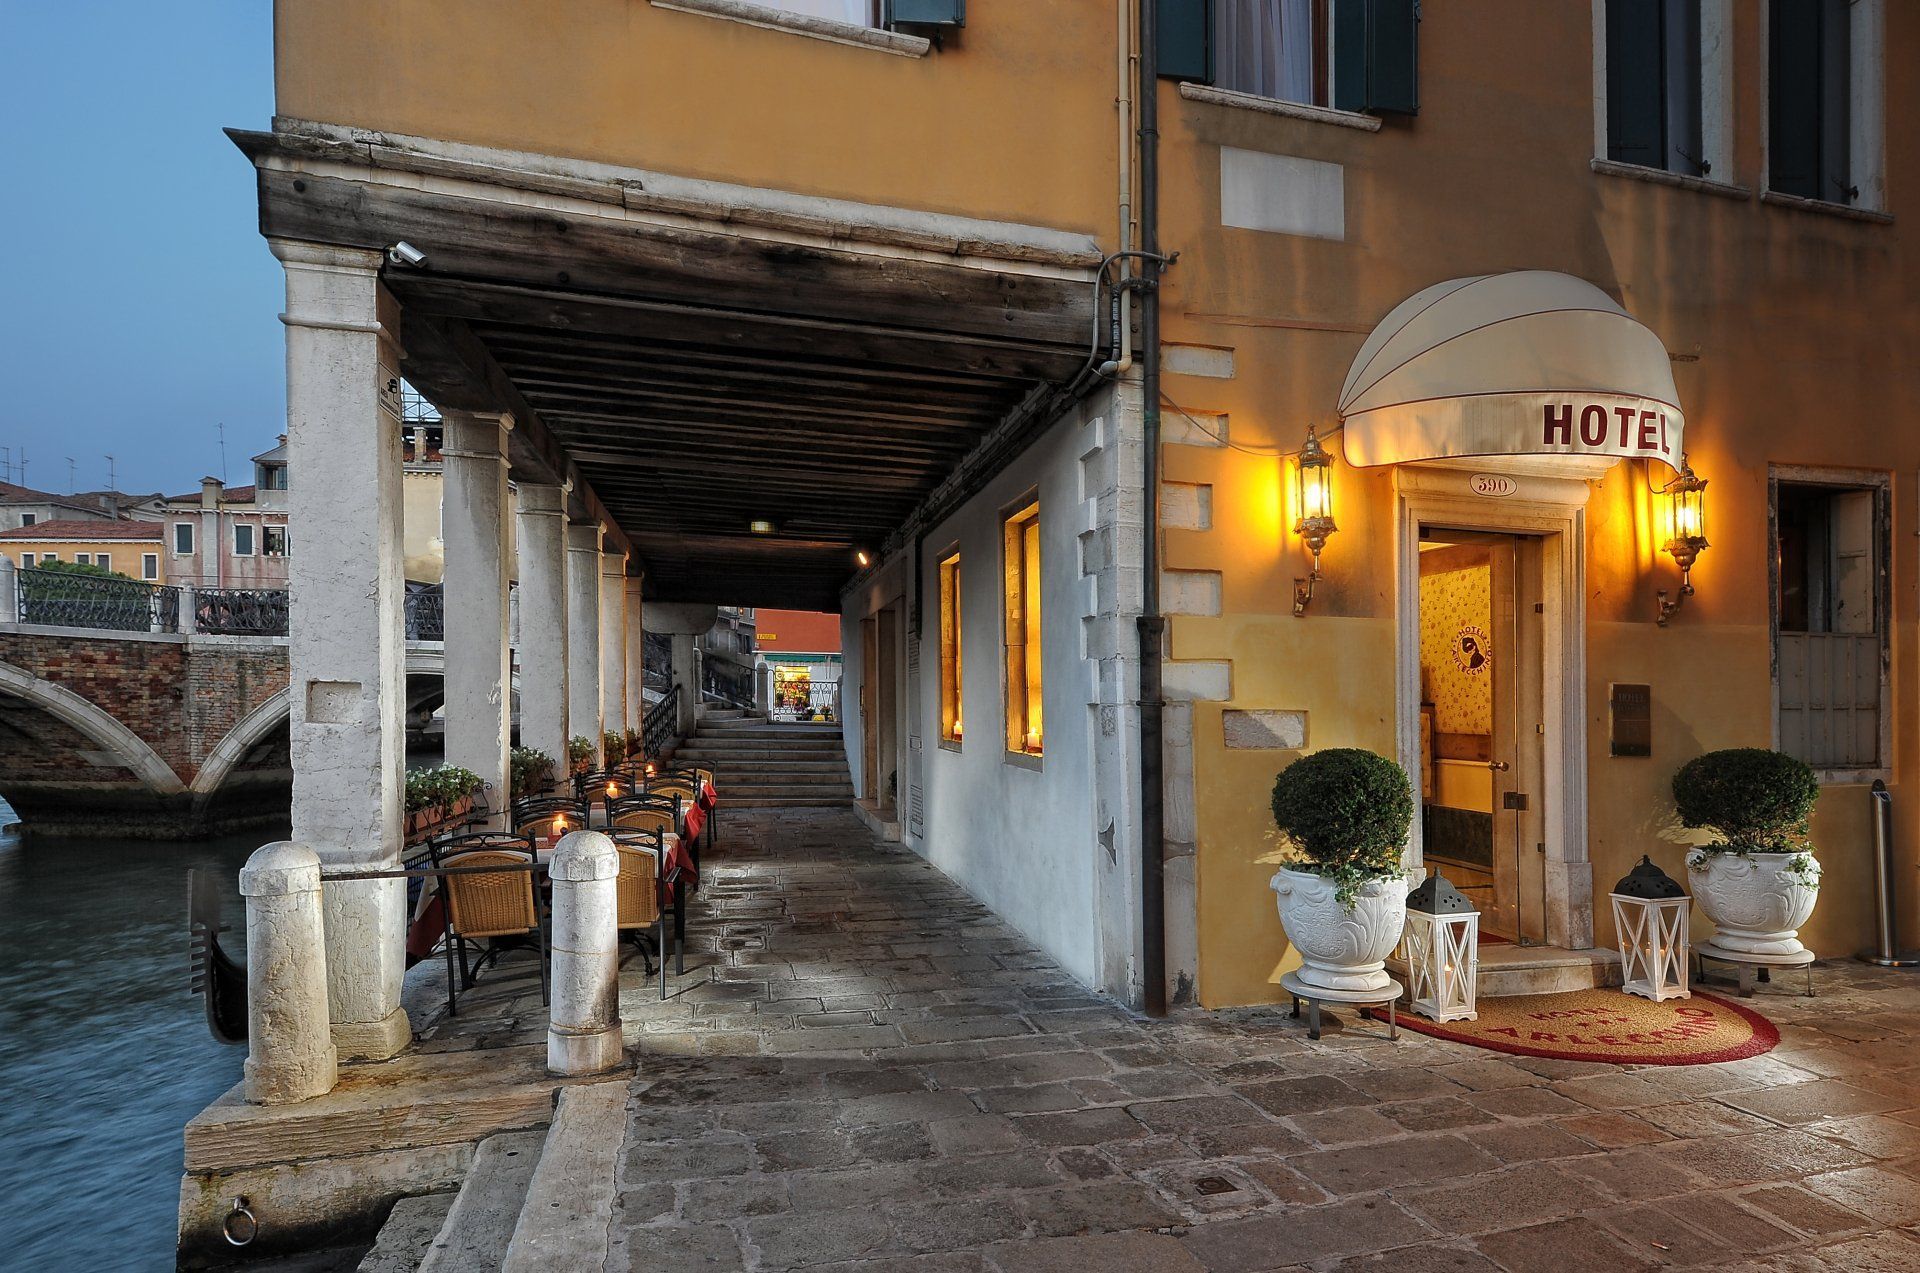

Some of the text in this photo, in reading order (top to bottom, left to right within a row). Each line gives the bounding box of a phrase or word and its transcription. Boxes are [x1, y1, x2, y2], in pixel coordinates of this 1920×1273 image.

[1543, 404, 1670, 455] HOTEL
[1478, 477, 1508, 493] 390
[1458, 626, 1486, 639] HOTEL
